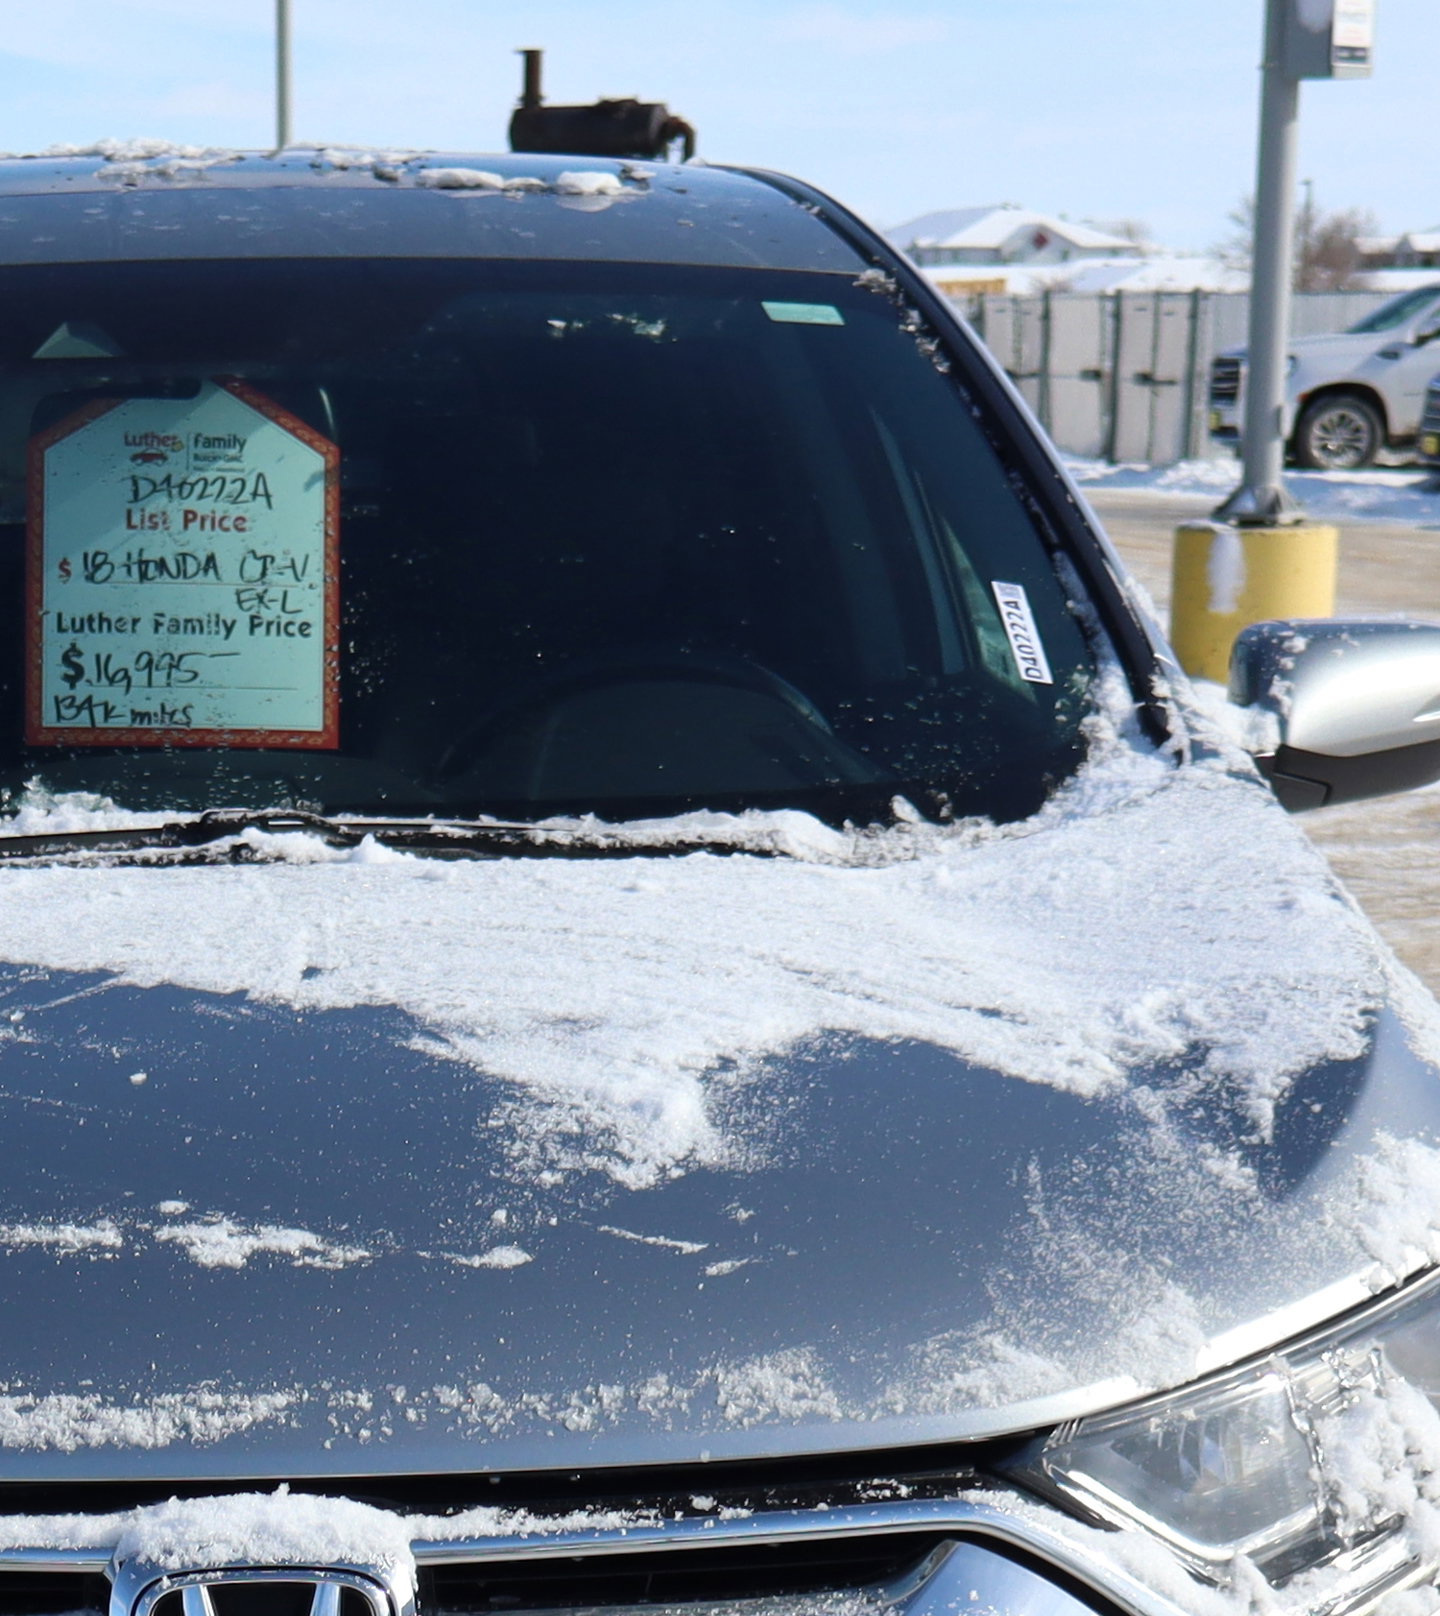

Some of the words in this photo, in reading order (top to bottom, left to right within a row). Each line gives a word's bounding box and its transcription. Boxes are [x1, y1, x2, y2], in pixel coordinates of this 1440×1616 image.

[123, 430, 179, 447] Luther
[193, 432, 249, 453] Family
[126, 510, 170, 532] List
[183, 509, 249, 533] Price
[56, 611, 142, 635] Luther
[153, 612, 237, 641] Family
[248, 614, 313, 638] Price
[1002, 600, 1044, 680] D40222A
